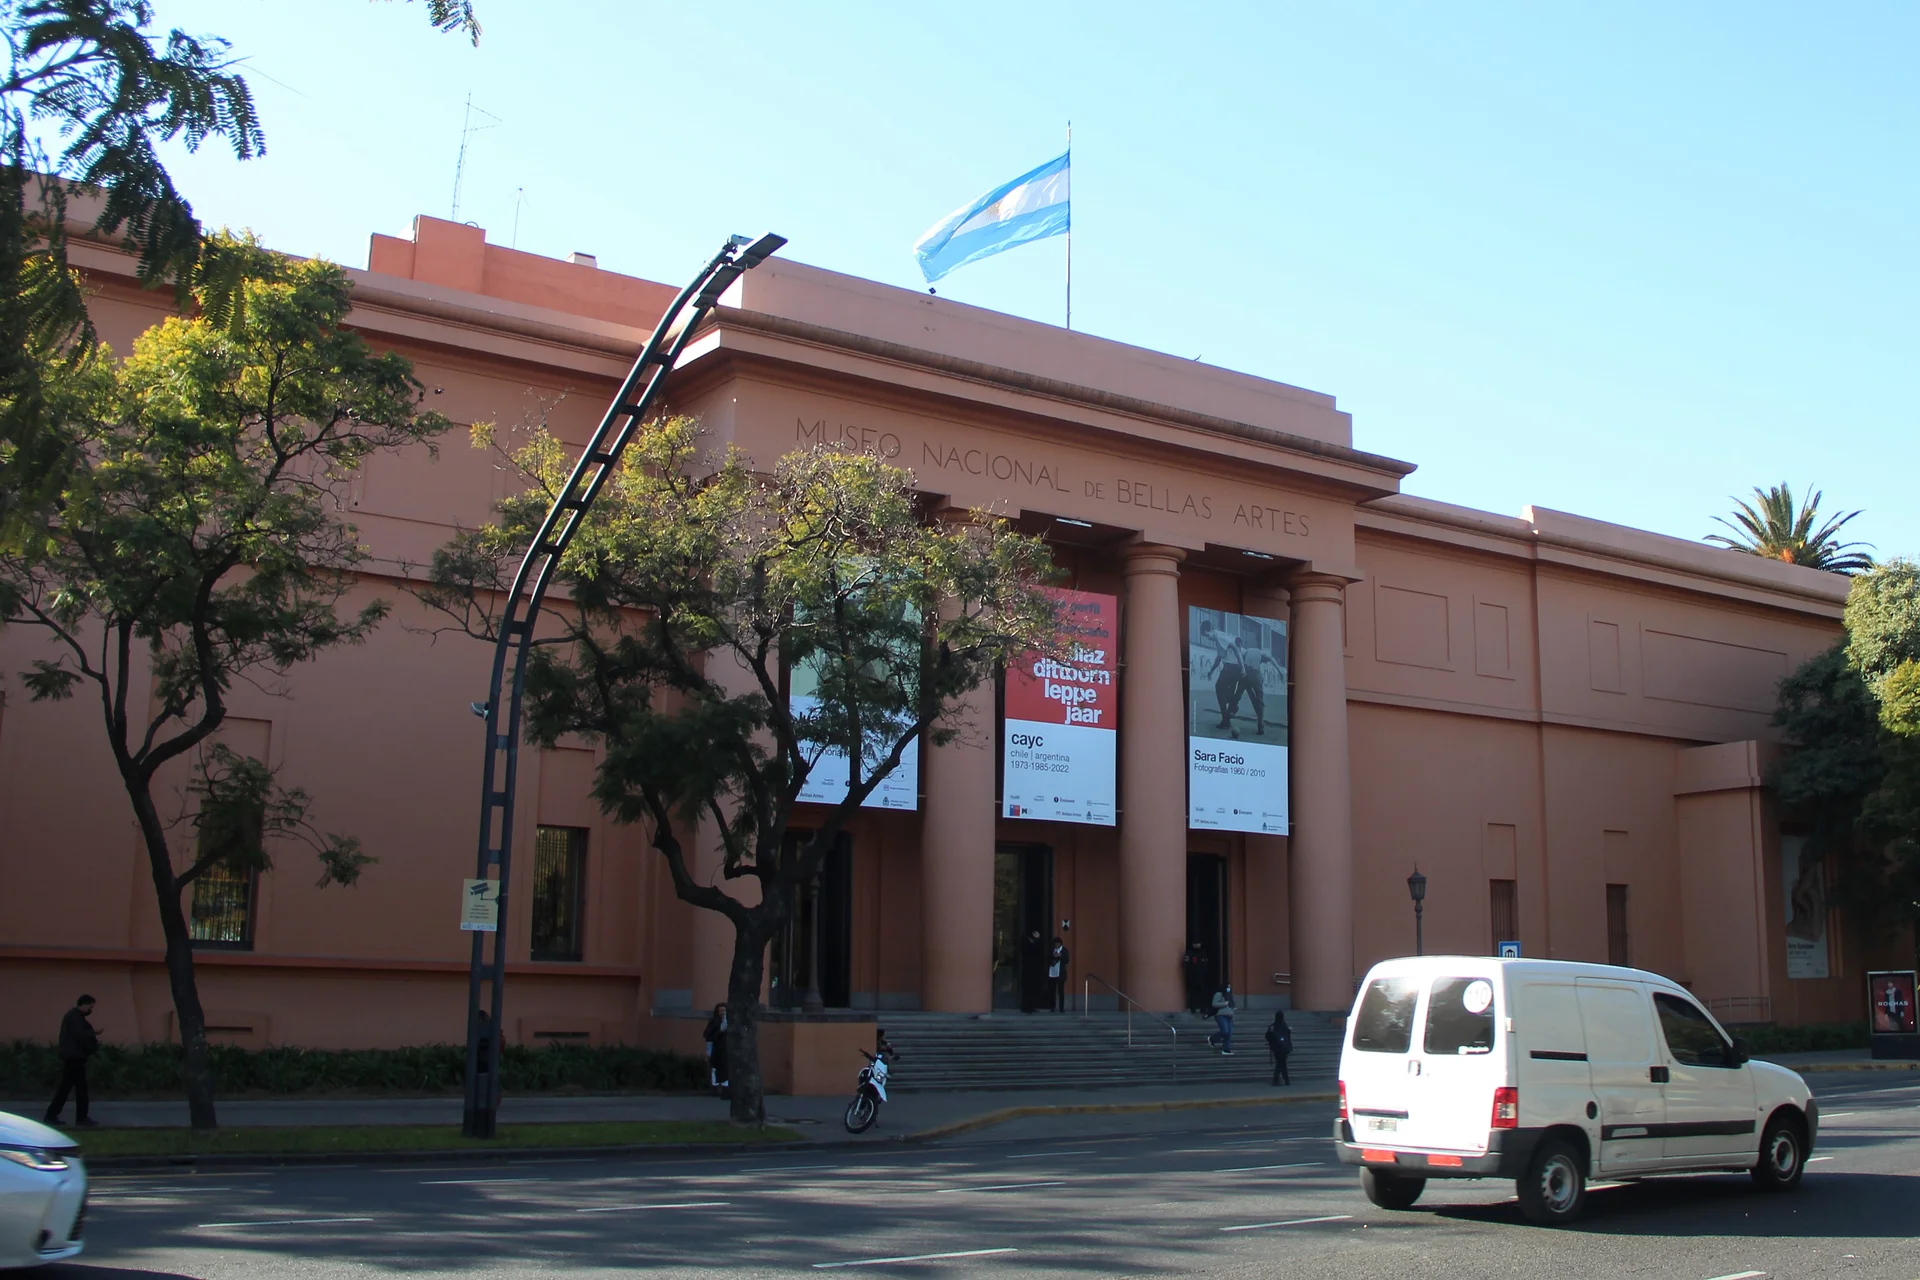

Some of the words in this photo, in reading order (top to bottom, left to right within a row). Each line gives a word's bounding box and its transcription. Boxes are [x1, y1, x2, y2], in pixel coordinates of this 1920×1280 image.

[796, 417, 901, 459] MUSEO
[923, 442, 1070, 493] NACIONAL
[1084, 480, 1106, 500] DE
[1117, 479, 1213, 519] BELLAS
[1233, 503, 1310, 537] ARTES
[1033, 657, 1110, 686] dittborn
[1044, 679, 1097, 705] leppe
[1064, 702, 1103, 725] jaar
[1011, 733, 1044, 749] cayc
[1010, 748, 1029, 759] chile
[1035, 752, 1070, 763] argentina
[1194, 749, 1217, 762] Sara
[1218, 752, 1245, 765] Facio
[1250, 769, 1266, 778] 2010
